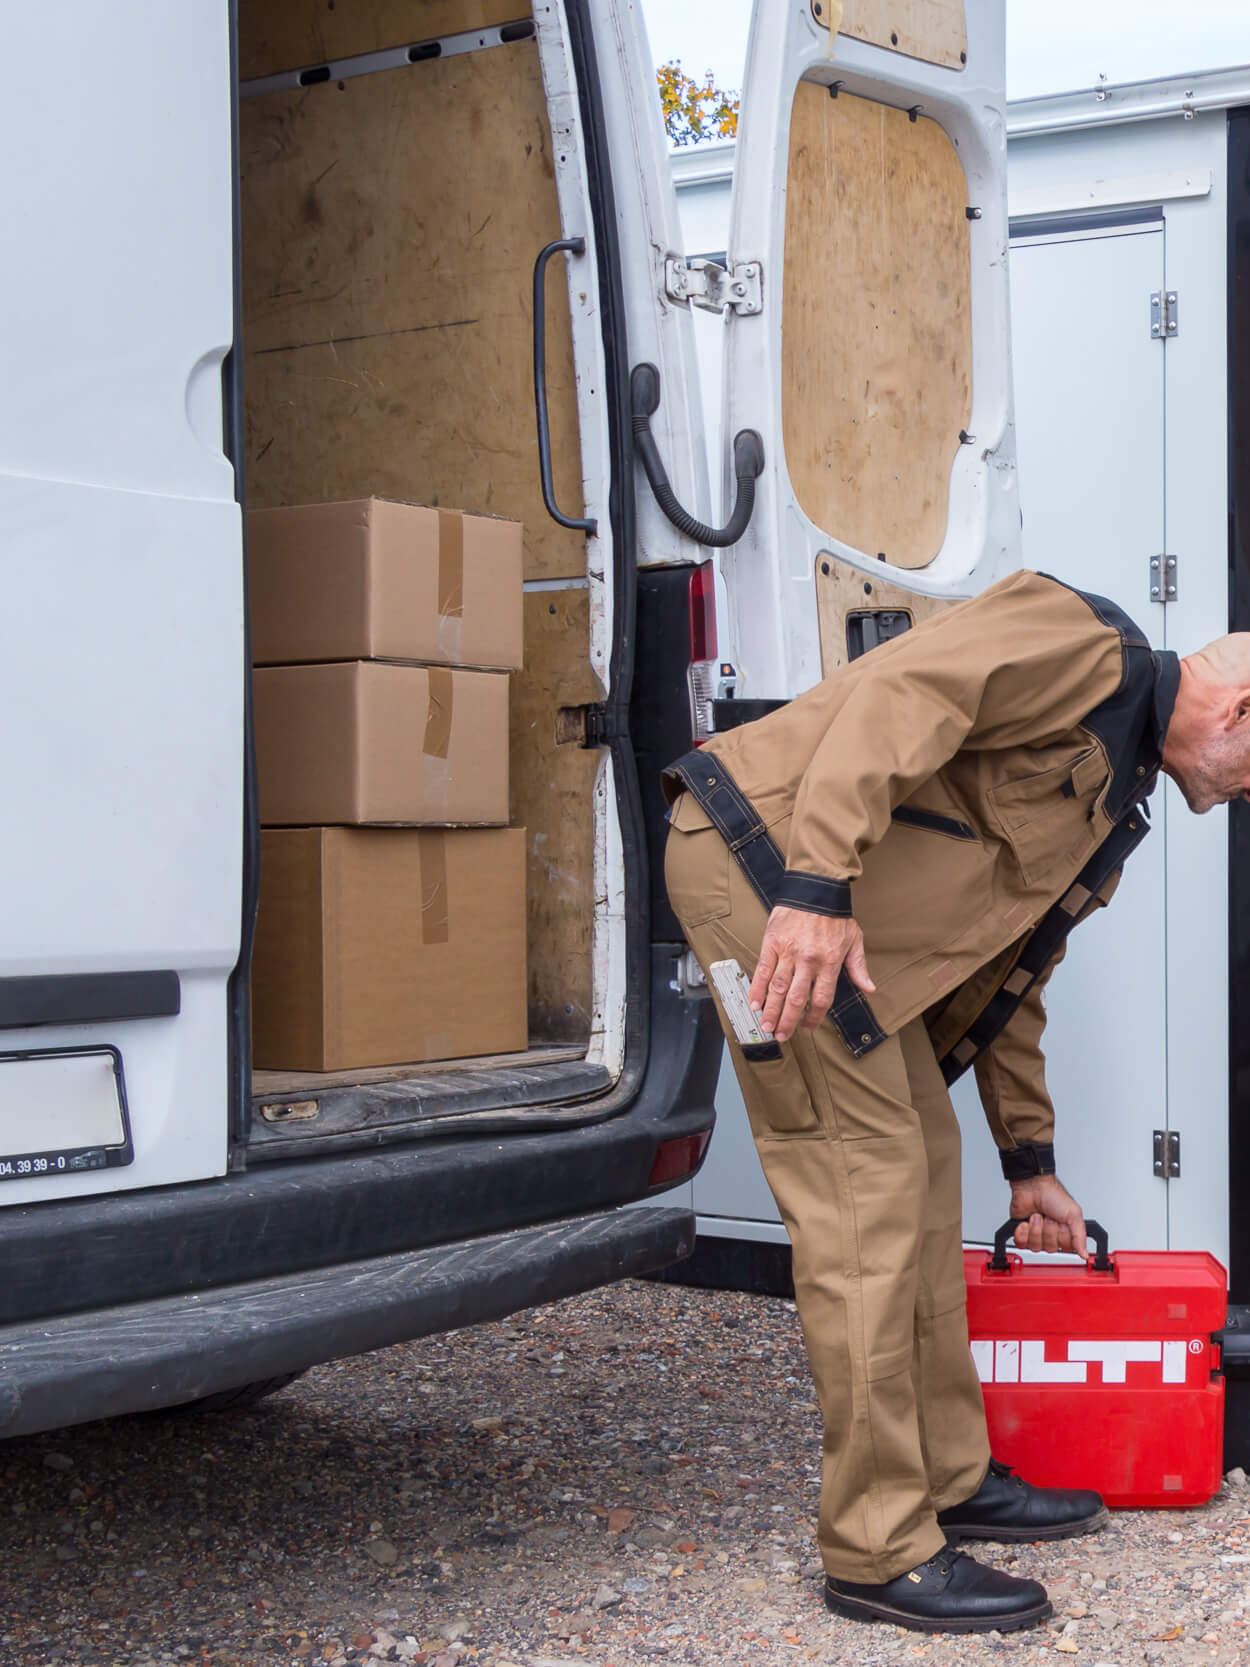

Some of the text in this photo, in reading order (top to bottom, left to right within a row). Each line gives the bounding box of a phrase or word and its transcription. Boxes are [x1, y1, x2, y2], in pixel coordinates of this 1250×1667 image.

[17, 1159, 32, 1174] 39
[33, 1158, 48, 1172] 39
[57, 1156, 66, 1169] 0
